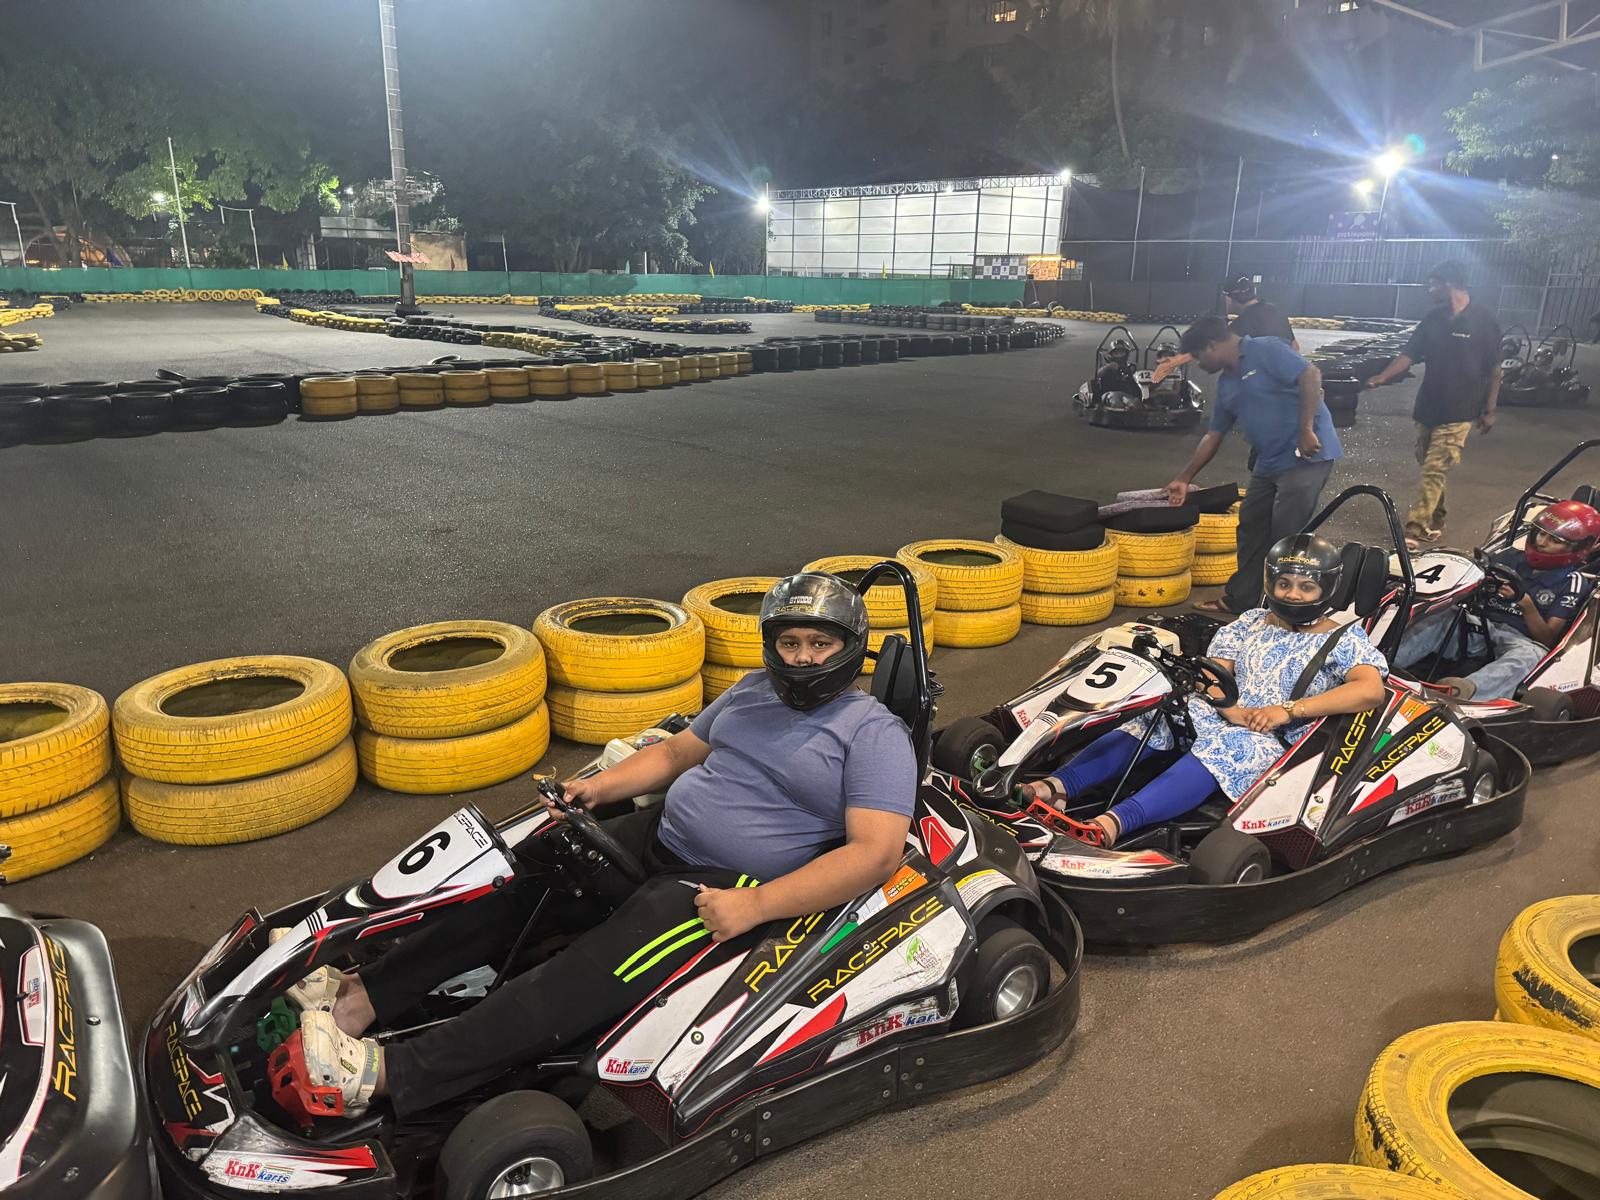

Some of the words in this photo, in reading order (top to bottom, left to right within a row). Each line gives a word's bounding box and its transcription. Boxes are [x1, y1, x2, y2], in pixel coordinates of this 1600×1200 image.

[1140, 371, 1151, 380] 12
[1415, 564, 1447, 584] 4
[1085, 662, 1127, 689] 5
[1366, 716, 1445, 779] RACEPACE
[1242, 820, 1267, 830] KnK
[397, 830, 451, 875] 6
[1061, 859, 1086, 870] KnK
[744, 908, 826, 993] RACE
[807, 896, 944, 1002] RACEPACE
[46, 936, 77, 1102] RACEPACE
[165, 1020, 203, 1122] RACEPACE
[605, 1058, 631, 1074] KnK
[628, 1065, 650, 1075] karts
[224, 1157, 264, 1181] KnK
[257, 1169, 290, 1184] karts
